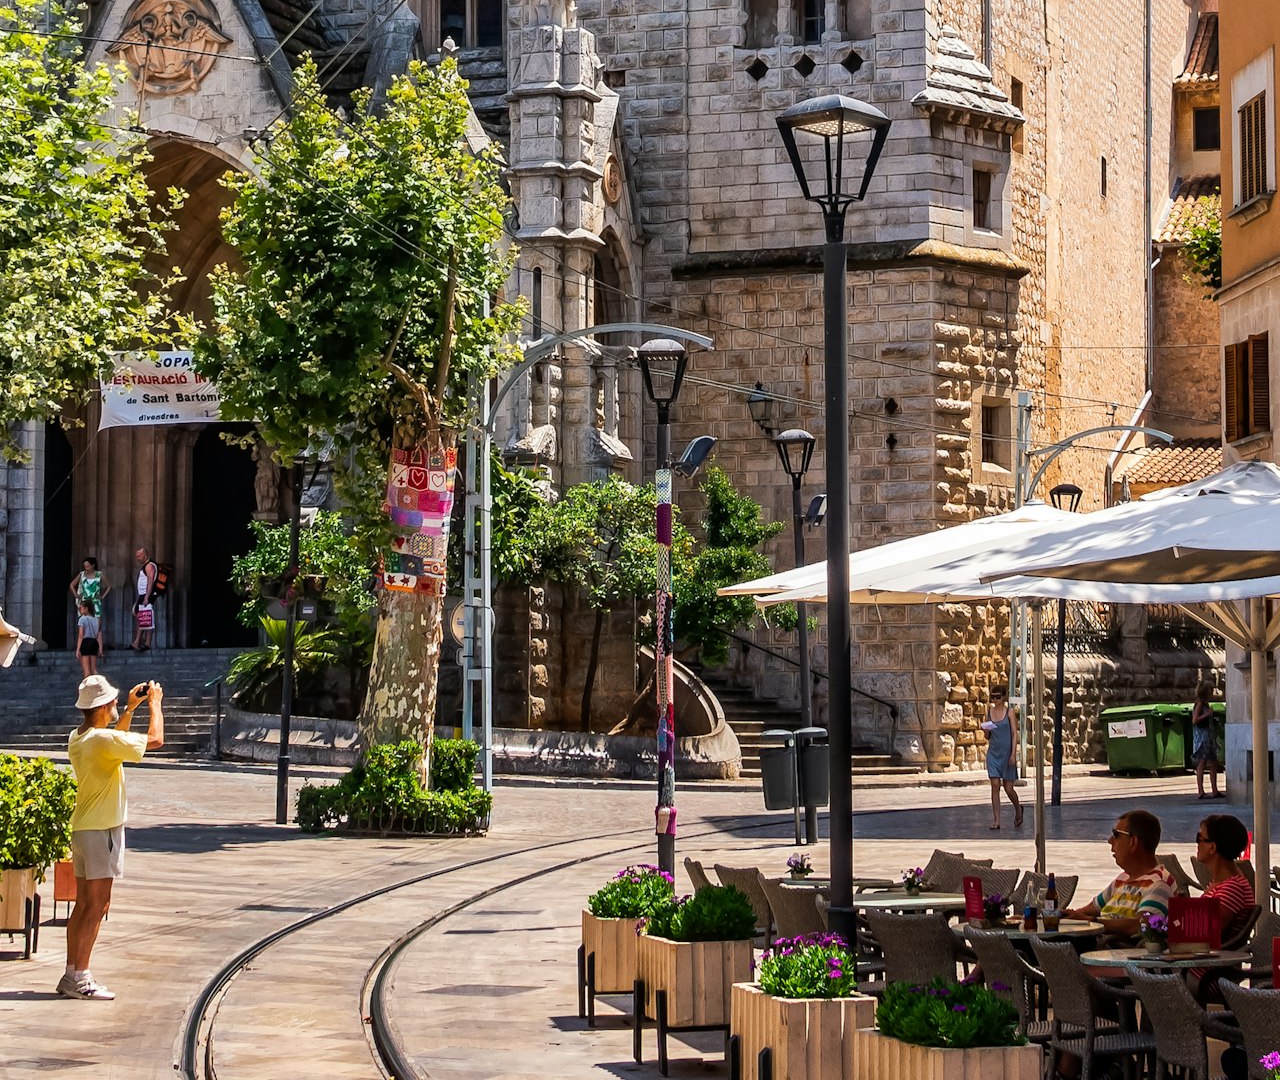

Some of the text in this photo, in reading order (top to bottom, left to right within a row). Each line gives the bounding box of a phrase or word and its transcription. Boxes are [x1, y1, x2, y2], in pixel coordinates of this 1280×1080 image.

[126, 397, 137, 405] de
[142, 393, 170, 404] Sant
[138, 413, 180, 422] divendres
